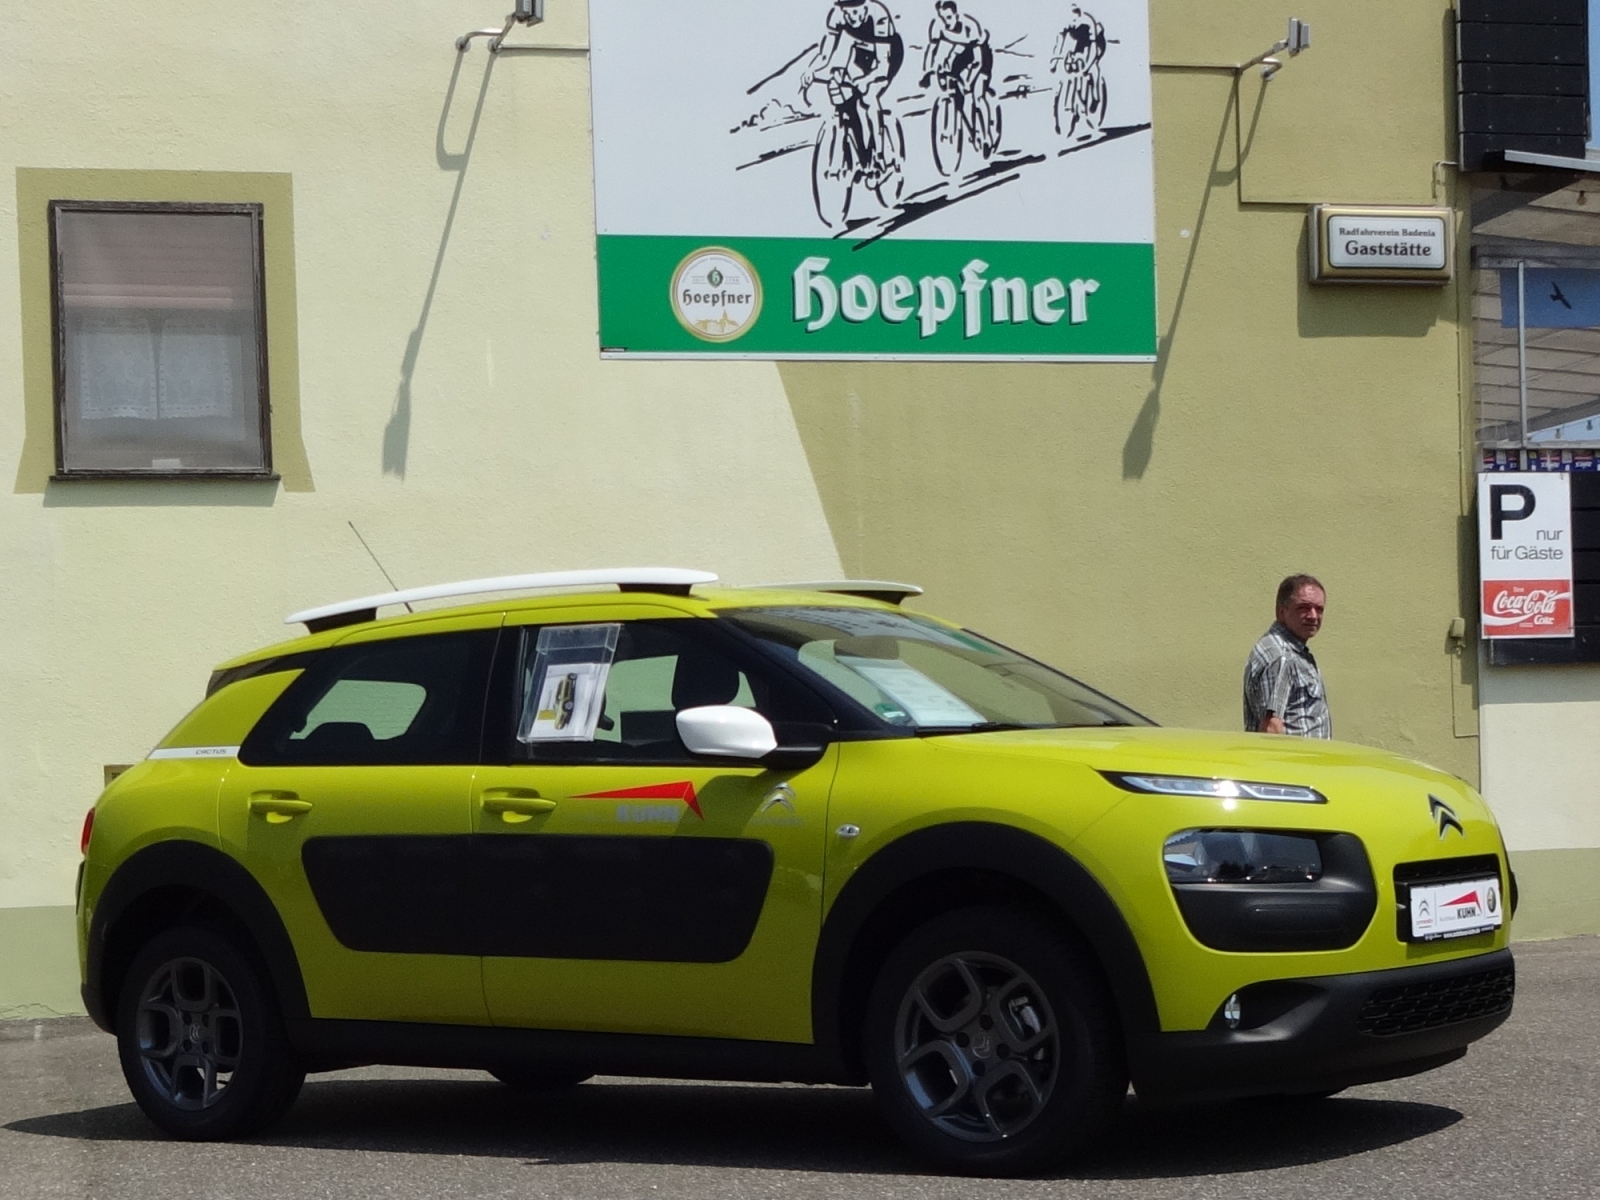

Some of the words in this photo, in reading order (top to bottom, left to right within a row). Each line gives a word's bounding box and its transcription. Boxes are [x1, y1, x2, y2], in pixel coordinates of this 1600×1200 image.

[1339, 228, 1400, 236] Radfahrverein
[1402, 229, 1436, 237] Badenia
[1345, 240, 1432, 256] Gaststätte
[682, 289, 752, 307] Hoepfner
[793, 256, 1101, 339] Hoepfner
[1490, 484, 1536, 540] P
[1536, 529, 1563, 540] nur
[1490, 545, 1513, 560] für
[1514, 545, 1563, 560] Gäste
[1456, 906, 1477, 919] KUHN
